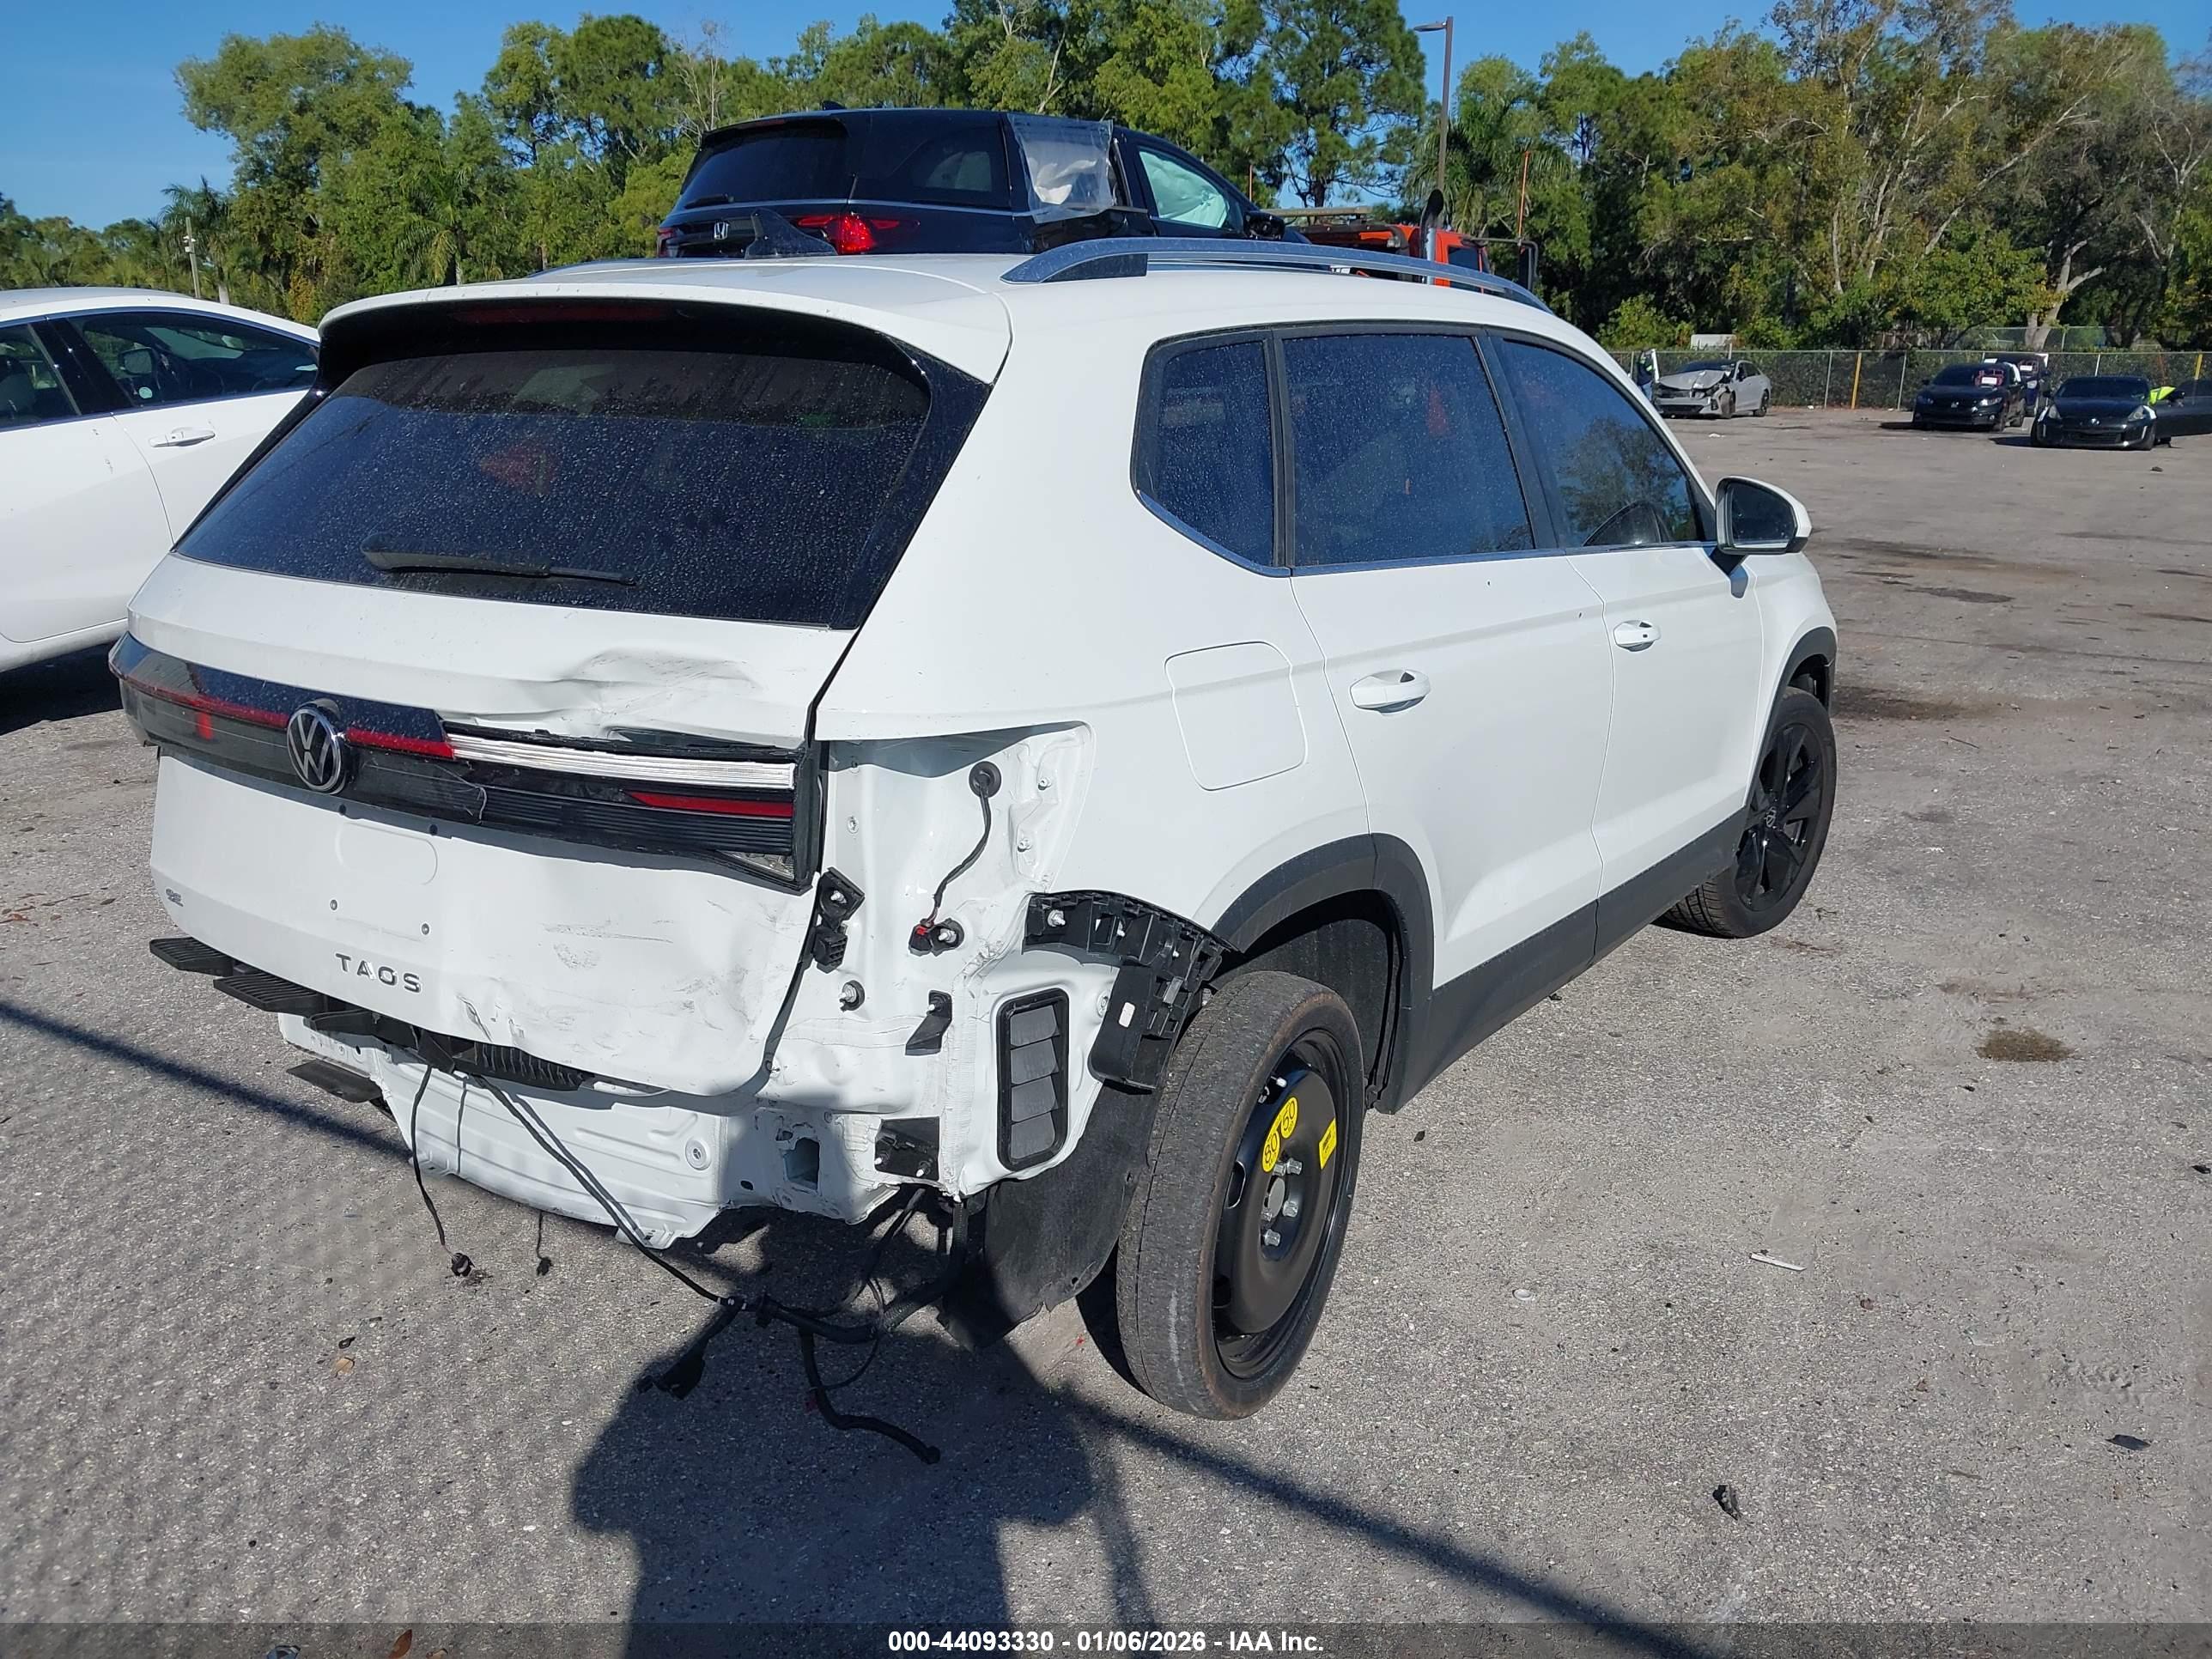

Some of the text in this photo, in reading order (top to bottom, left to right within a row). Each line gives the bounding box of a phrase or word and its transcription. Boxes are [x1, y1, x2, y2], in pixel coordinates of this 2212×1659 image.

[335, 952, 422, 994] TAOS
[1282, 1100, 1296, 1132] 50
[1265, 1133, 1278, 1164] 80
